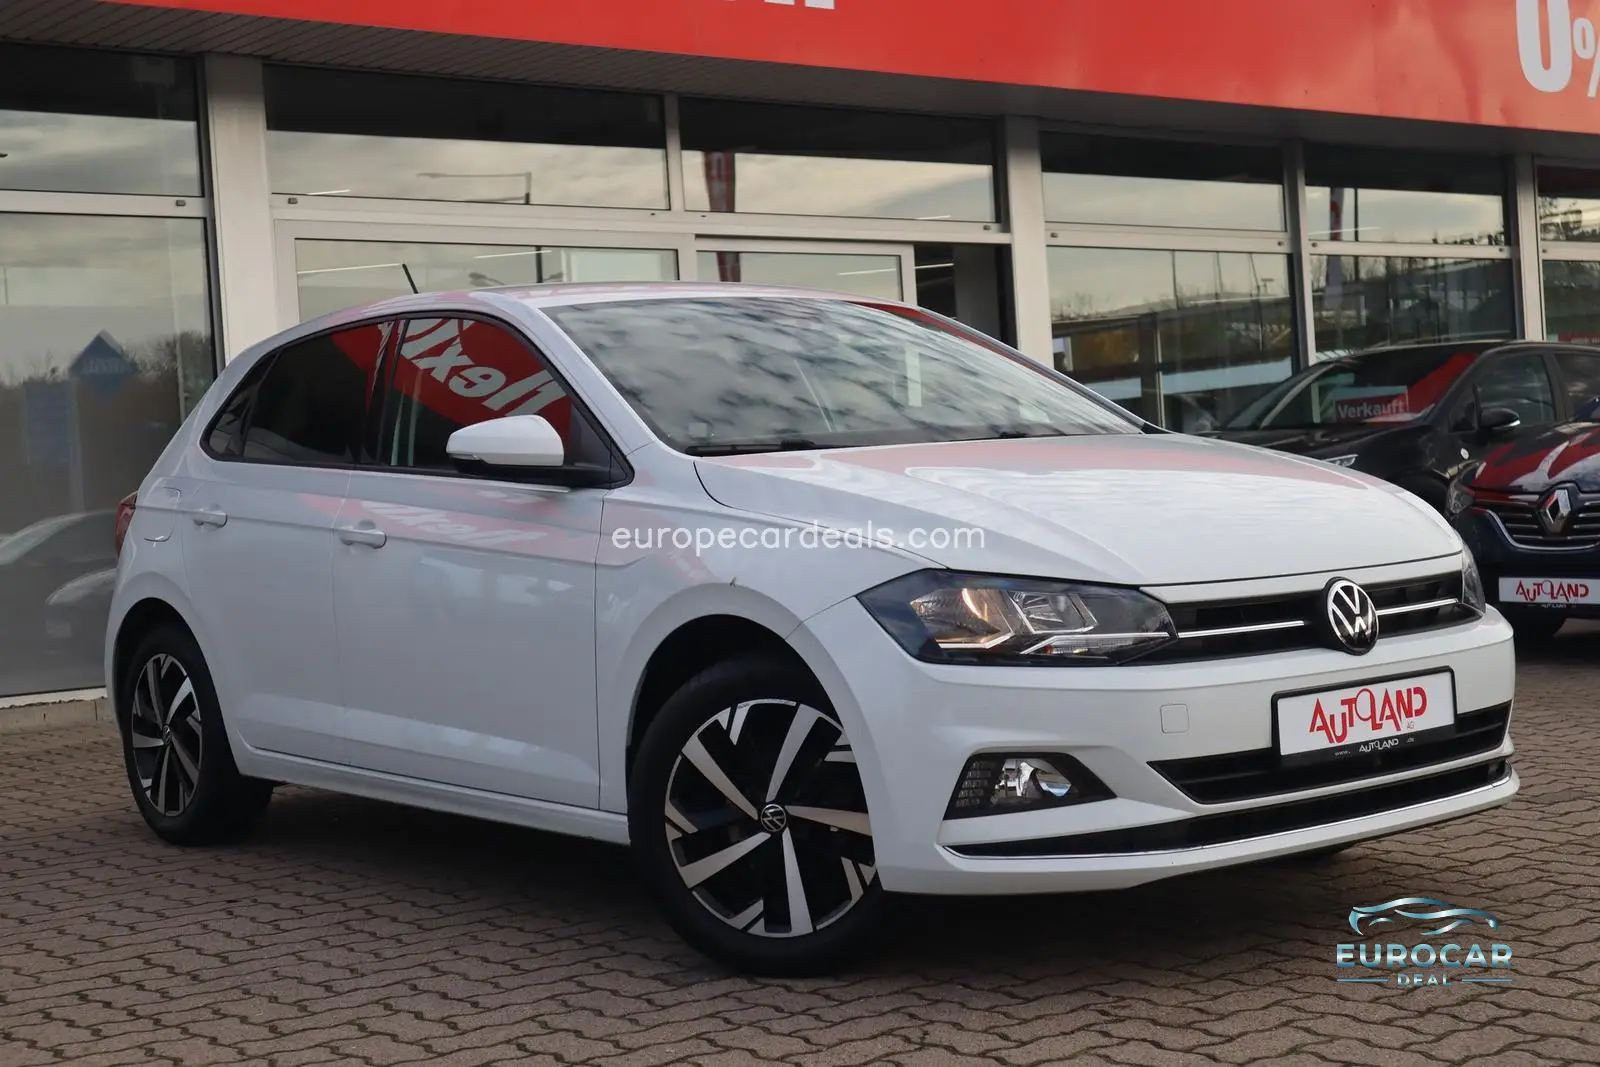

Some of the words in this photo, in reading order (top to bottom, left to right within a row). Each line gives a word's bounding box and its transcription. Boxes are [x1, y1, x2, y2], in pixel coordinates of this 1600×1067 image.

[1337, 400, 1406, 419] Verkauft
[1515, 580, 1590, 602] AUTOLAND
[1309, 686, 1429, 744] AUTOLAND
[1358, 738, 1400, 753] AUTOLAND
